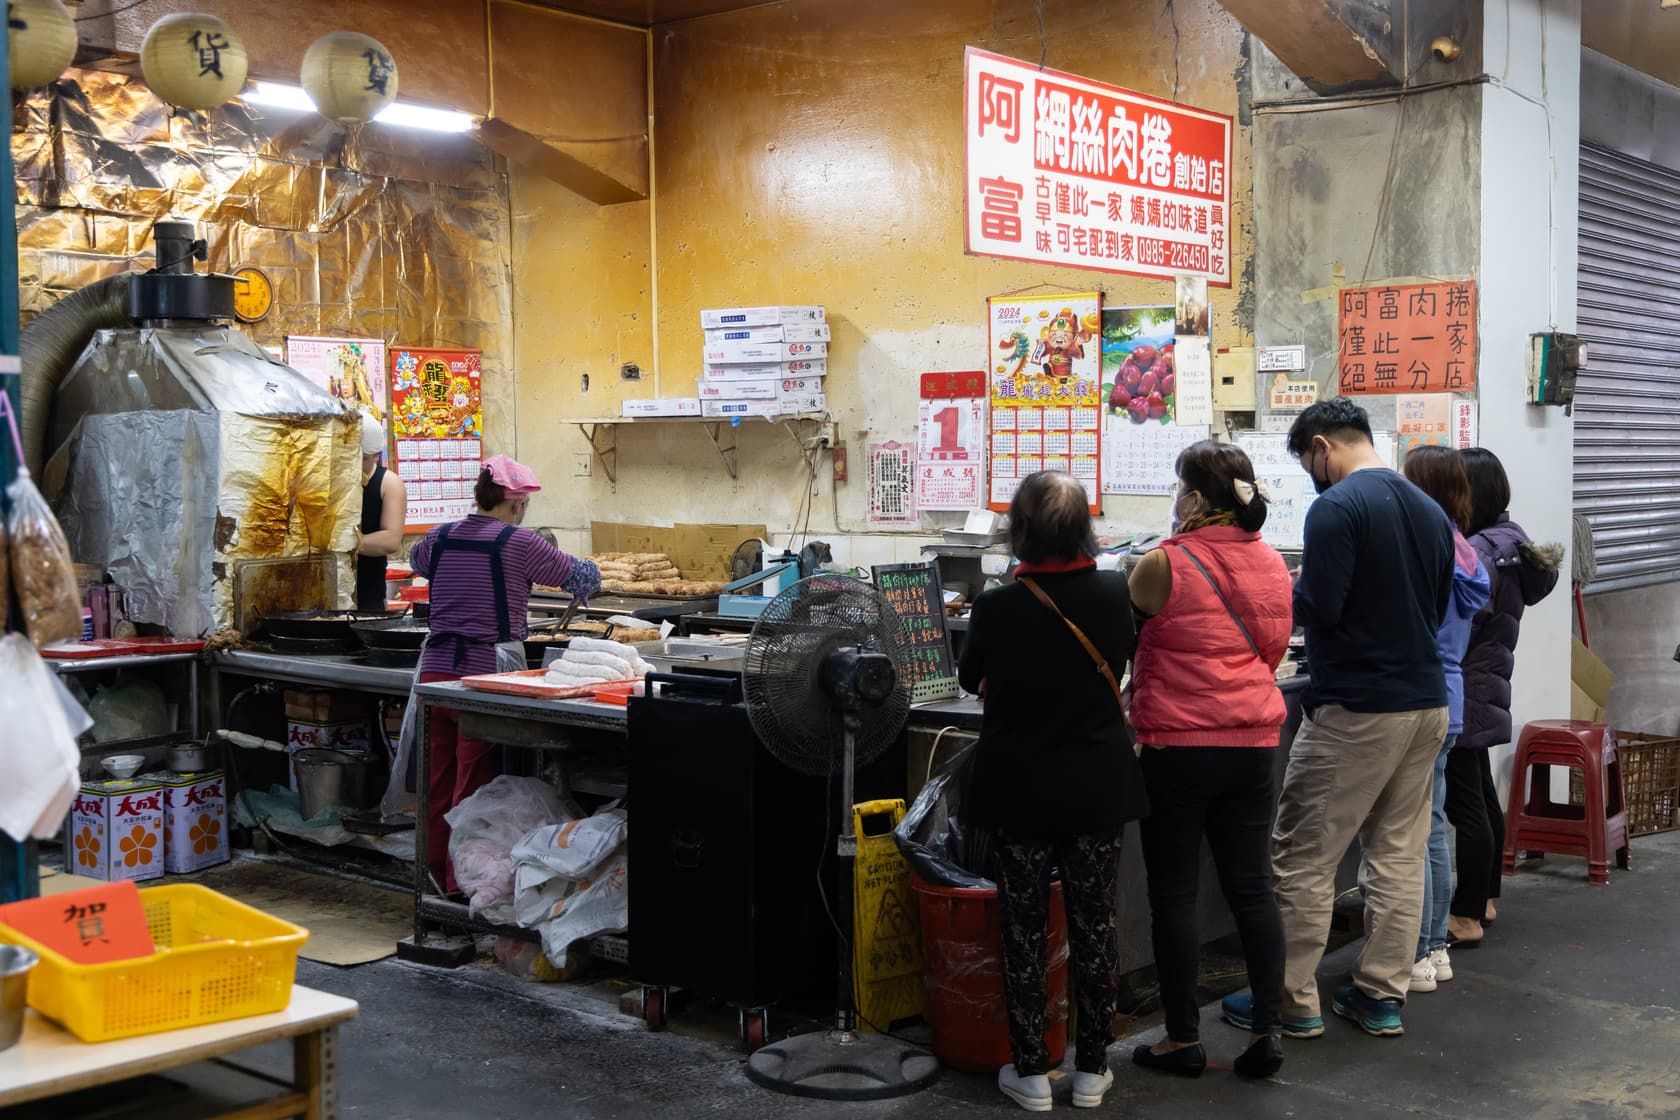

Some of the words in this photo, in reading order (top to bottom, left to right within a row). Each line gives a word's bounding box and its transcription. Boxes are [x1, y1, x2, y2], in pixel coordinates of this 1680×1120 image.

[188, 30, 229, 80] 貨
[978, 71, 1024, 243] 阿富
[1035, 87, 1172, 187] 網絲肉捲
[1173, 151, 1224, 195] 創始店
[1034, 175, 1053, 253] 古早味
[1054, 181, 1123, 222] 僅此一家
[1130, 194, 1208, 235] 媽媽的味道
[1055, 222, 1134, 261] 可宅配到家
[1138, 239, 1208, 270] 0985-226450
[998, 307, 1021, 318] 2024
[1343, 285, 1471, 320] 阿富肉捲
[1342, 320, 1468, 357] 僅此一家
[1341, 358, 1466, 393] 絕無分店
[932, 406, 966, 451] 1
[72, 793, 105, 818] 大成
[115, 791, 162, 817] 大成
[182, 778, 225, 807] 大成
[64, 902, 110, 947] 賀
